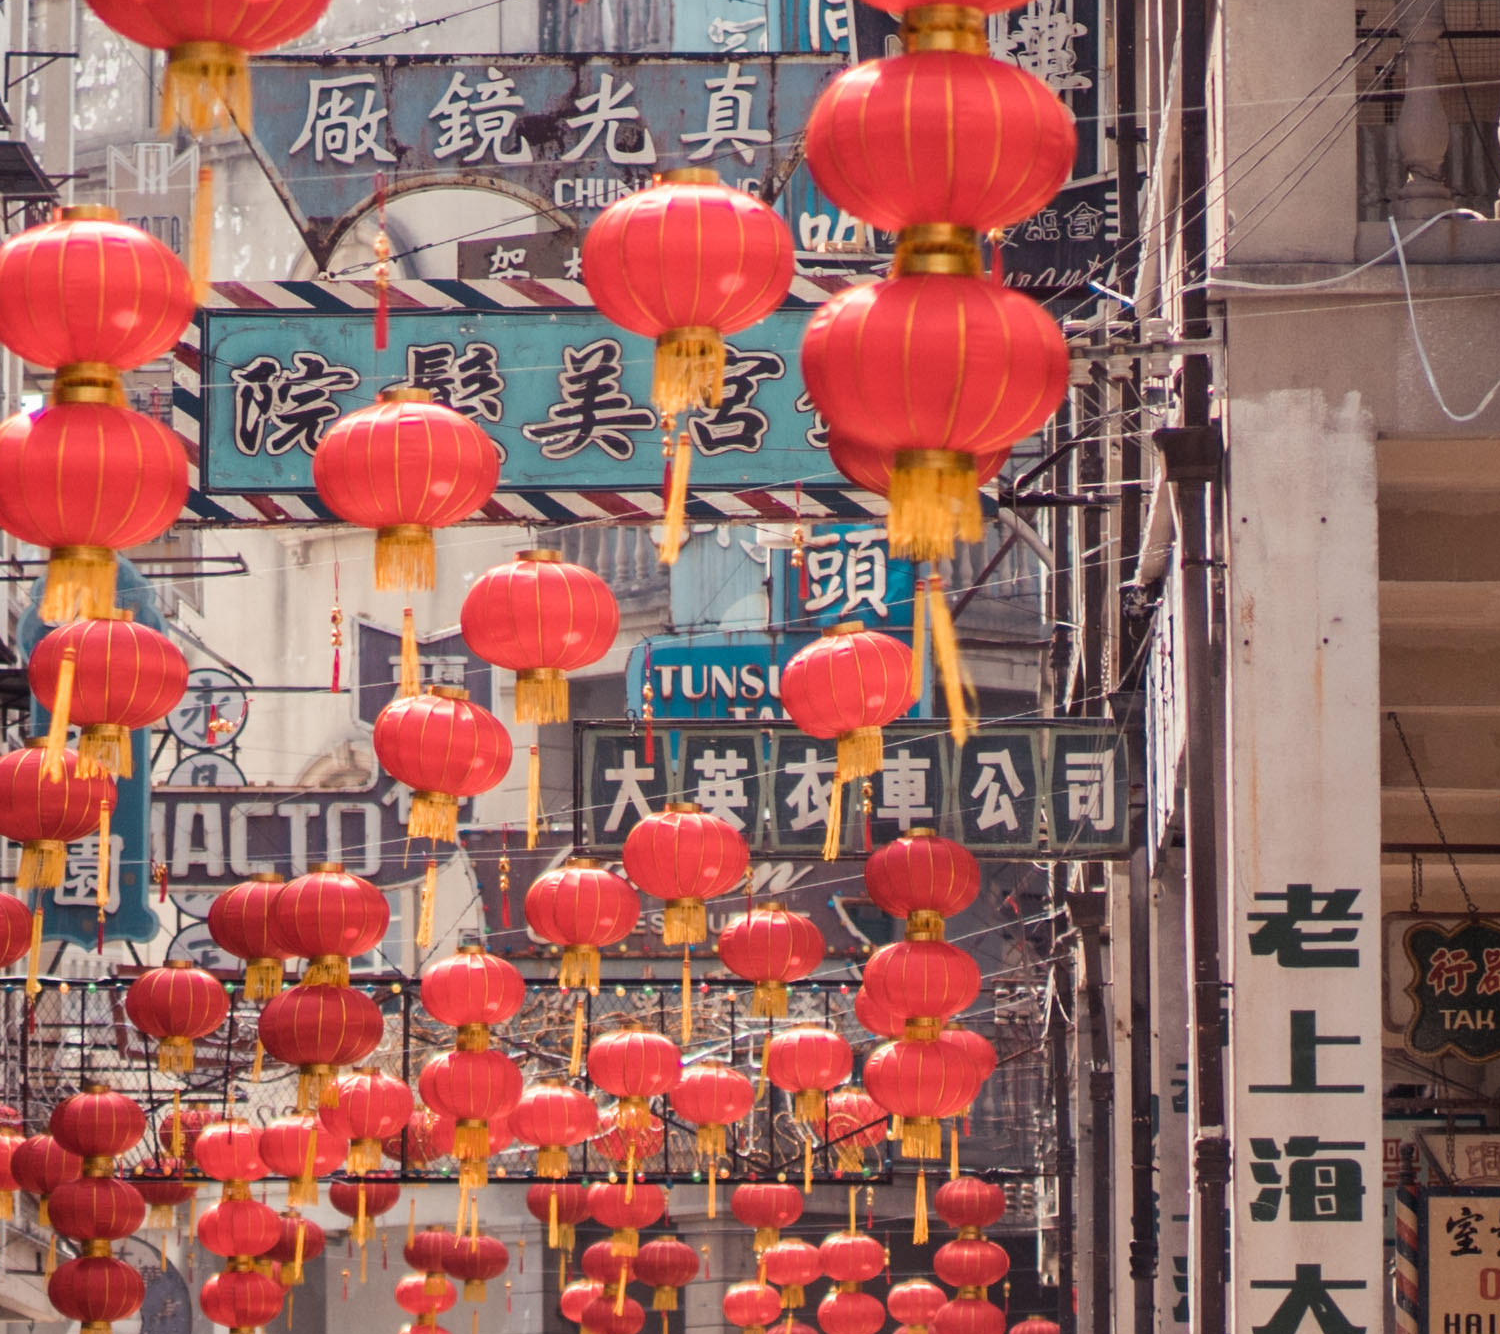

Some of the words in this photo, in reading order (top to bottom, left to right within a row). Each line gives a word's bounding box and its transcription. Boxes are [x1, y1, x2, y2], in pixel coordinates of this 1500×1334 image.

[228, 335, 830, 463] 宮美髮院
[804, 527, 890, 618] 頭
[603, 749, 1117, 833] 大英衣車公司
[1438, 1009, 1498, 1033] TAK
